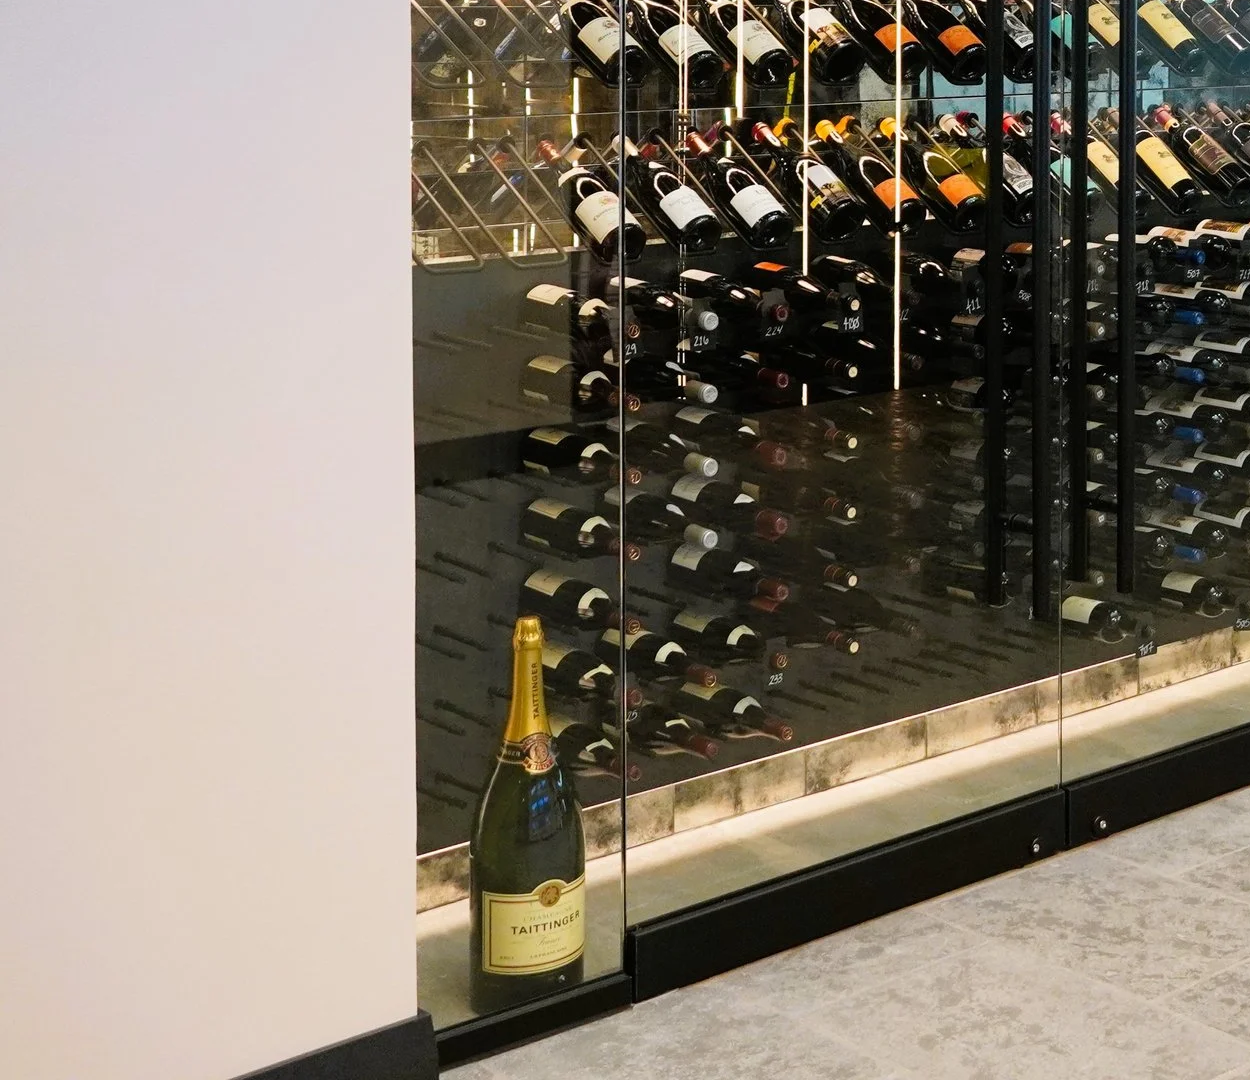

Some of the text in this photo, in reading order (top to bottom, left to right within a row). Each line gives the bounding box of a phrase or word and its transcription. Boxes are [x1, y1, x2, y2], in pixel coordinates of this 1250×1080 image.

[900, 308, 909, 321] 12
[765, 325, 784, 336] 224
[694, 335, 709, 347] 216
[625, 344, 637, 356] 29
[768, 673, 783, 686] 233
[531, 662, 540, 720] TAITTINGER
[510, 910, 580, 936] TAITTINGER
